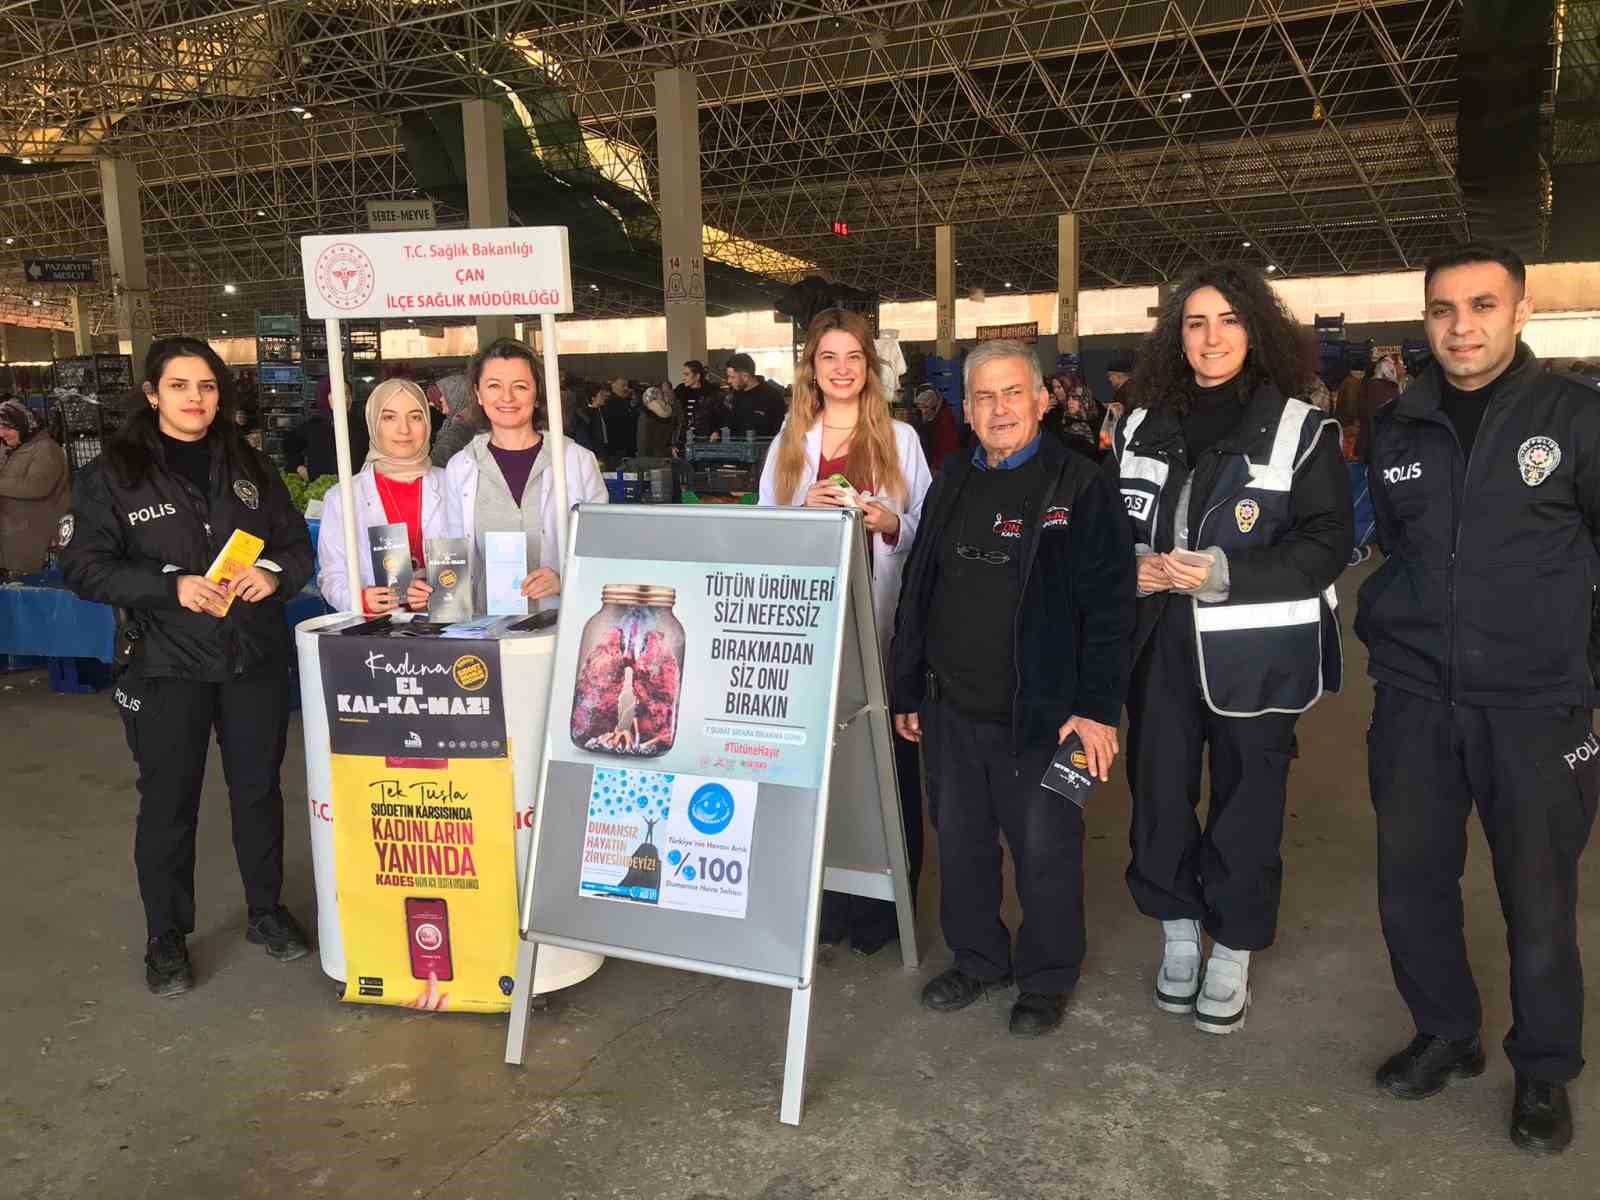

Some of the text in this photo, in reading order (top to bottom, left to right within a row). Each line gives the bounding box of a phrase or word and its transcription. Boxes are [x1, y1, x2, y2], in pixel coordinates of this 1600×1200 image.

[402, 241, 534, 260] T.C. Sağlık Bakanlığı
[455, 269, 485, 286] ÇAN
[386, 290, 560, 311] İLÇE SAĞLIK MÜDÜRLÜĞÜ
[705, 572, 835, 602] TÜTÜN ÜRÜNLERİ
[714, 598, 821, 628] SİZİ NEFESSİZ
[711, 638, 814, 666] BIRAKMADAN
[396, 677, 423, 696] EL
[730, 663, 789, 692] SİZ ONU
[336, 694, 491, 716] KAL-KA-MAZ!
[725, 692, 788, 719] BIRAKIN
[369, 780, 469, 804] Tek Tuşla
[372, 818, 475, 846] KADINLARIN
[588, 821, 639, 839] DUMANSIZ
[586, 836, 627, 852] HAYATIN
[374, 843, 477, 877] YANINDA
[584, 849, 657, 872] ZİRVESİNDEYİZ!
[375, 874, 415, 888] KADES
